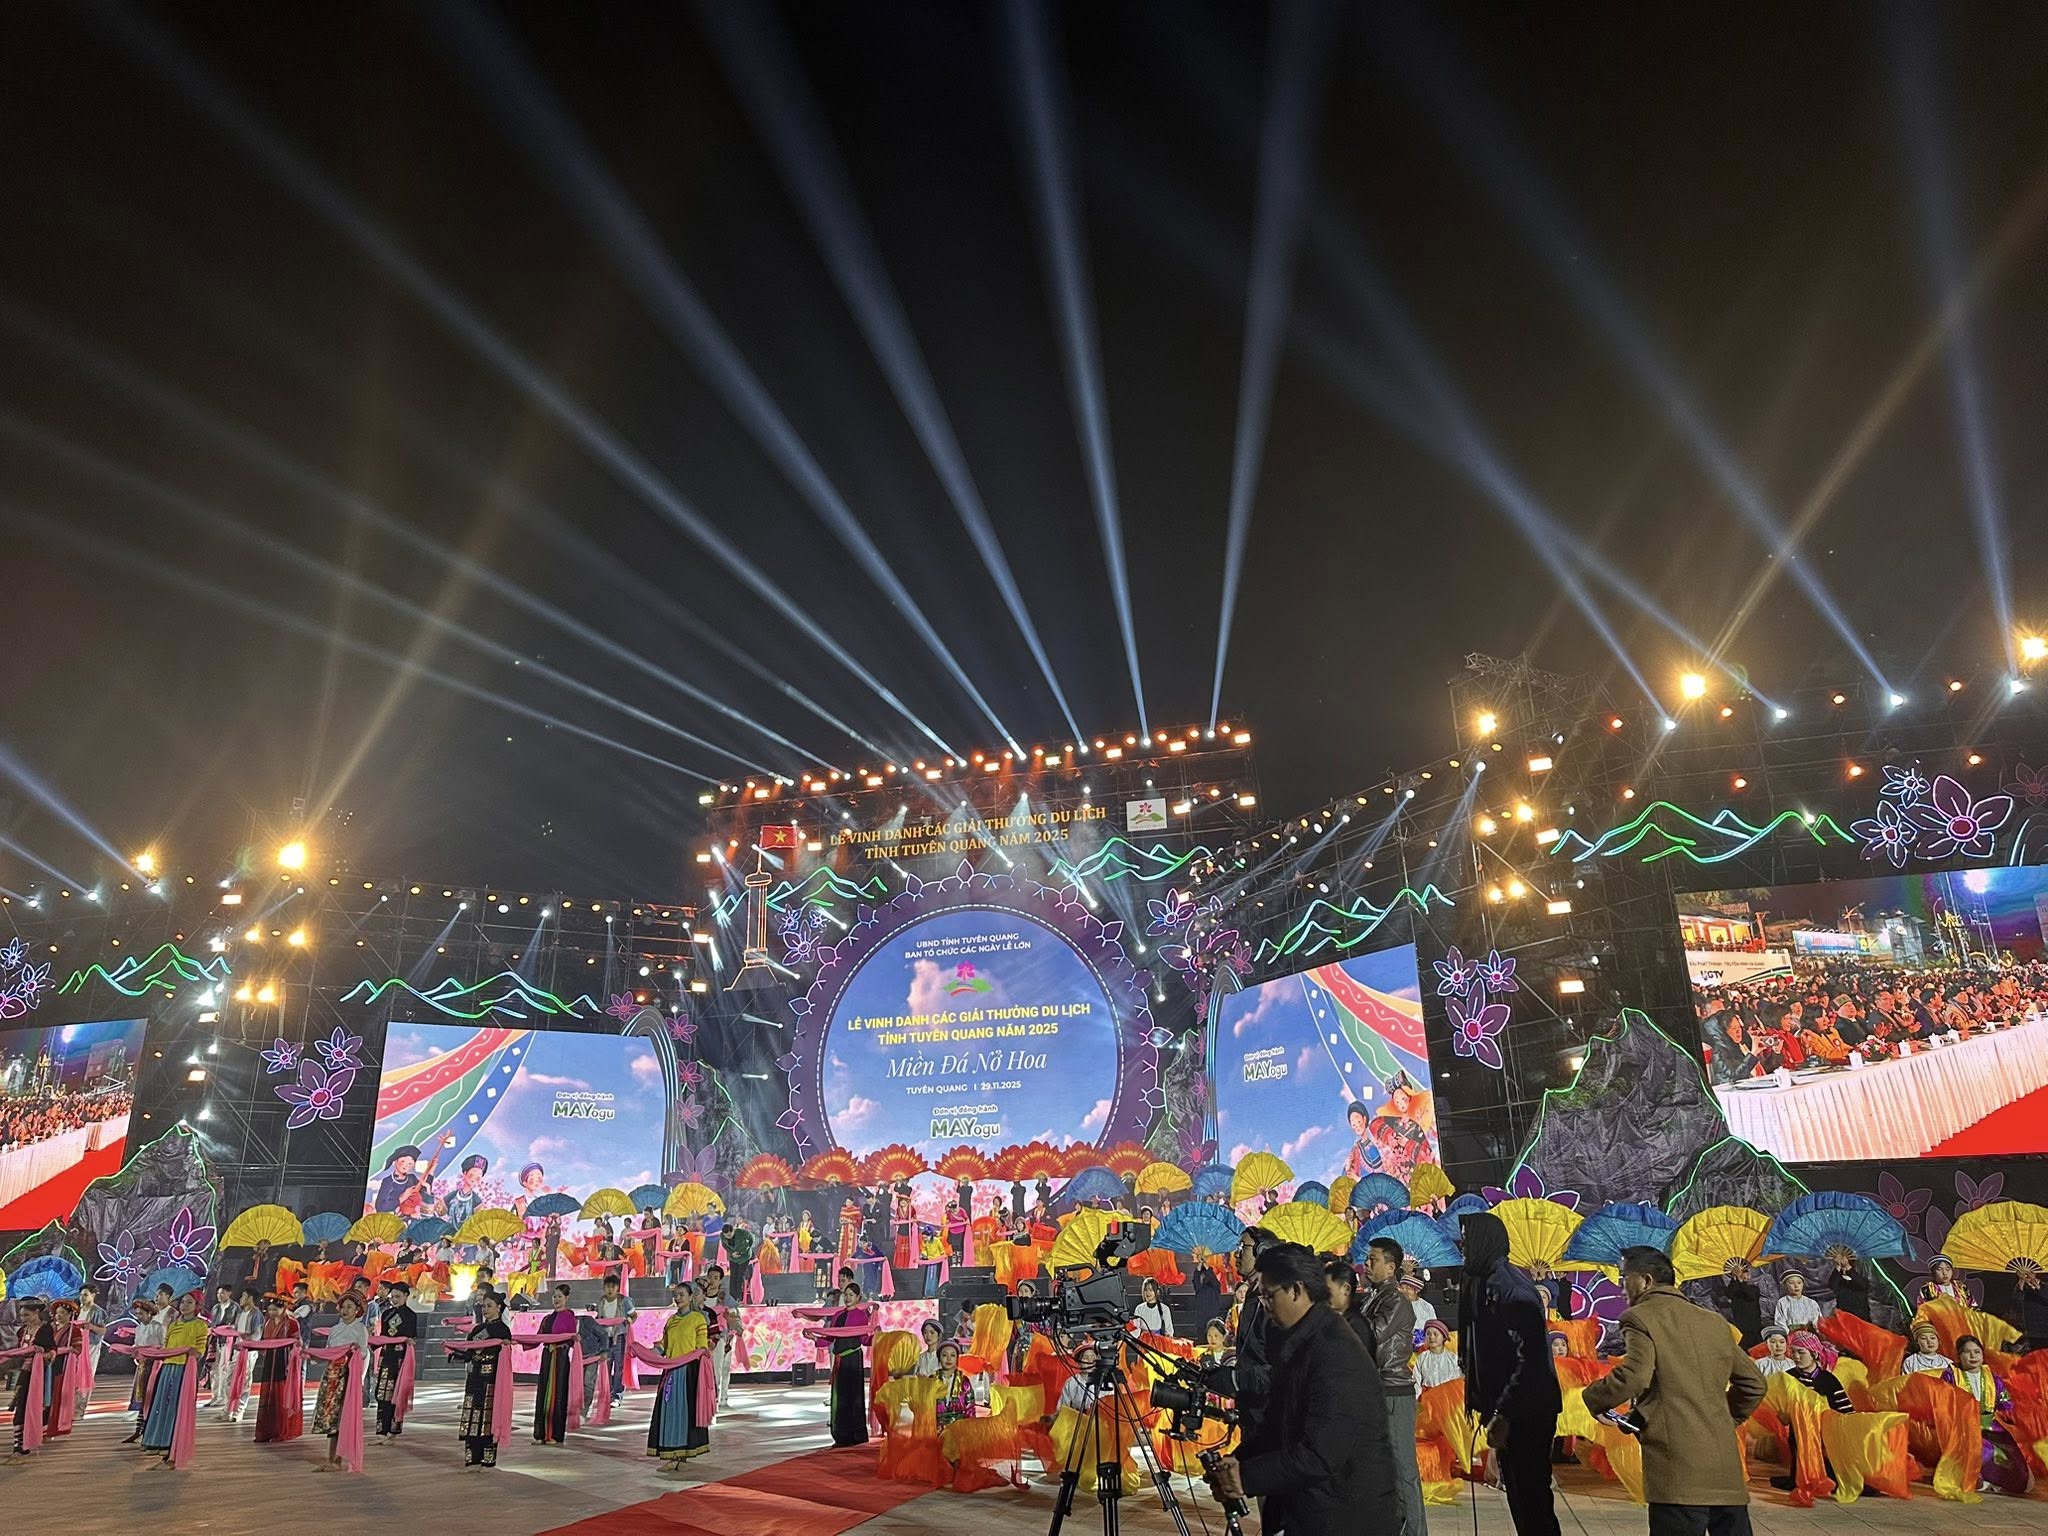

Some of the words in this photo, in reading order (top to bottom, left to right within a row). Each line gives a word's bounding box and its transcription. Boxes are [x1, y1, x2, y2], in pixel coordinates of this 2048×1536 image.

[849, 830, 881, 844] VINH
[885, 826, 922, 840] DANH
[926, 821, 951, 836] CÁC
[1050, 810, 1070, 824] DU
[1074, 807, 1106, 822] LỊCH
[865, 844, 899, 859] TỈNH
[901, 840, 945, 856] TUYÊN
[1000, 831, 1030, 846] NĂM
[1034, 828, 1069, 843] 2025
[905, 950, 922, 959] BAN
[960, 944, 977, 954] CÁC
[916, 939, 940, 948] UBND
[961, 935, 988, 944] TUYÊN
[989, 933, 1019, 943] QUANG
[864, 1017, 893, 1029] VINH
[895, 1014, 929, 1027] DANH
[932, 1010, 957, 1024] CÁC
[959, 1008, 984, 1022] GIẢI
[986, 1004, 1039, 1020] THƯỞNG
[1042, 1005, 1059, 1017] DU
[1061, 1003, 1091, 1017] LỊCH
[877, 1031, 907, 1046] TỈNH
[909, 1028, 948, 1043] TUYÊN
[951, 1026, 994, 1042] QUANG
[996, 1023, 1026, 1037] NĂM
[1028, 1023, 1059, 1036] 2025
[886, 1050, 935, 1078] Miền
[940, 1051, 970, 1075] Đá
[1006, 1050, 1047, 1071] Hoa
[906, 1084, 934, 1095] TUYÊN
[936, 1083, 968, 1095] QUANG
[980, 1081, 1021, 1091] 29.11.2025
[552, 1101, 615, 1122] MAYogu
[931, 1117, 1001, 1139] MAYogu
